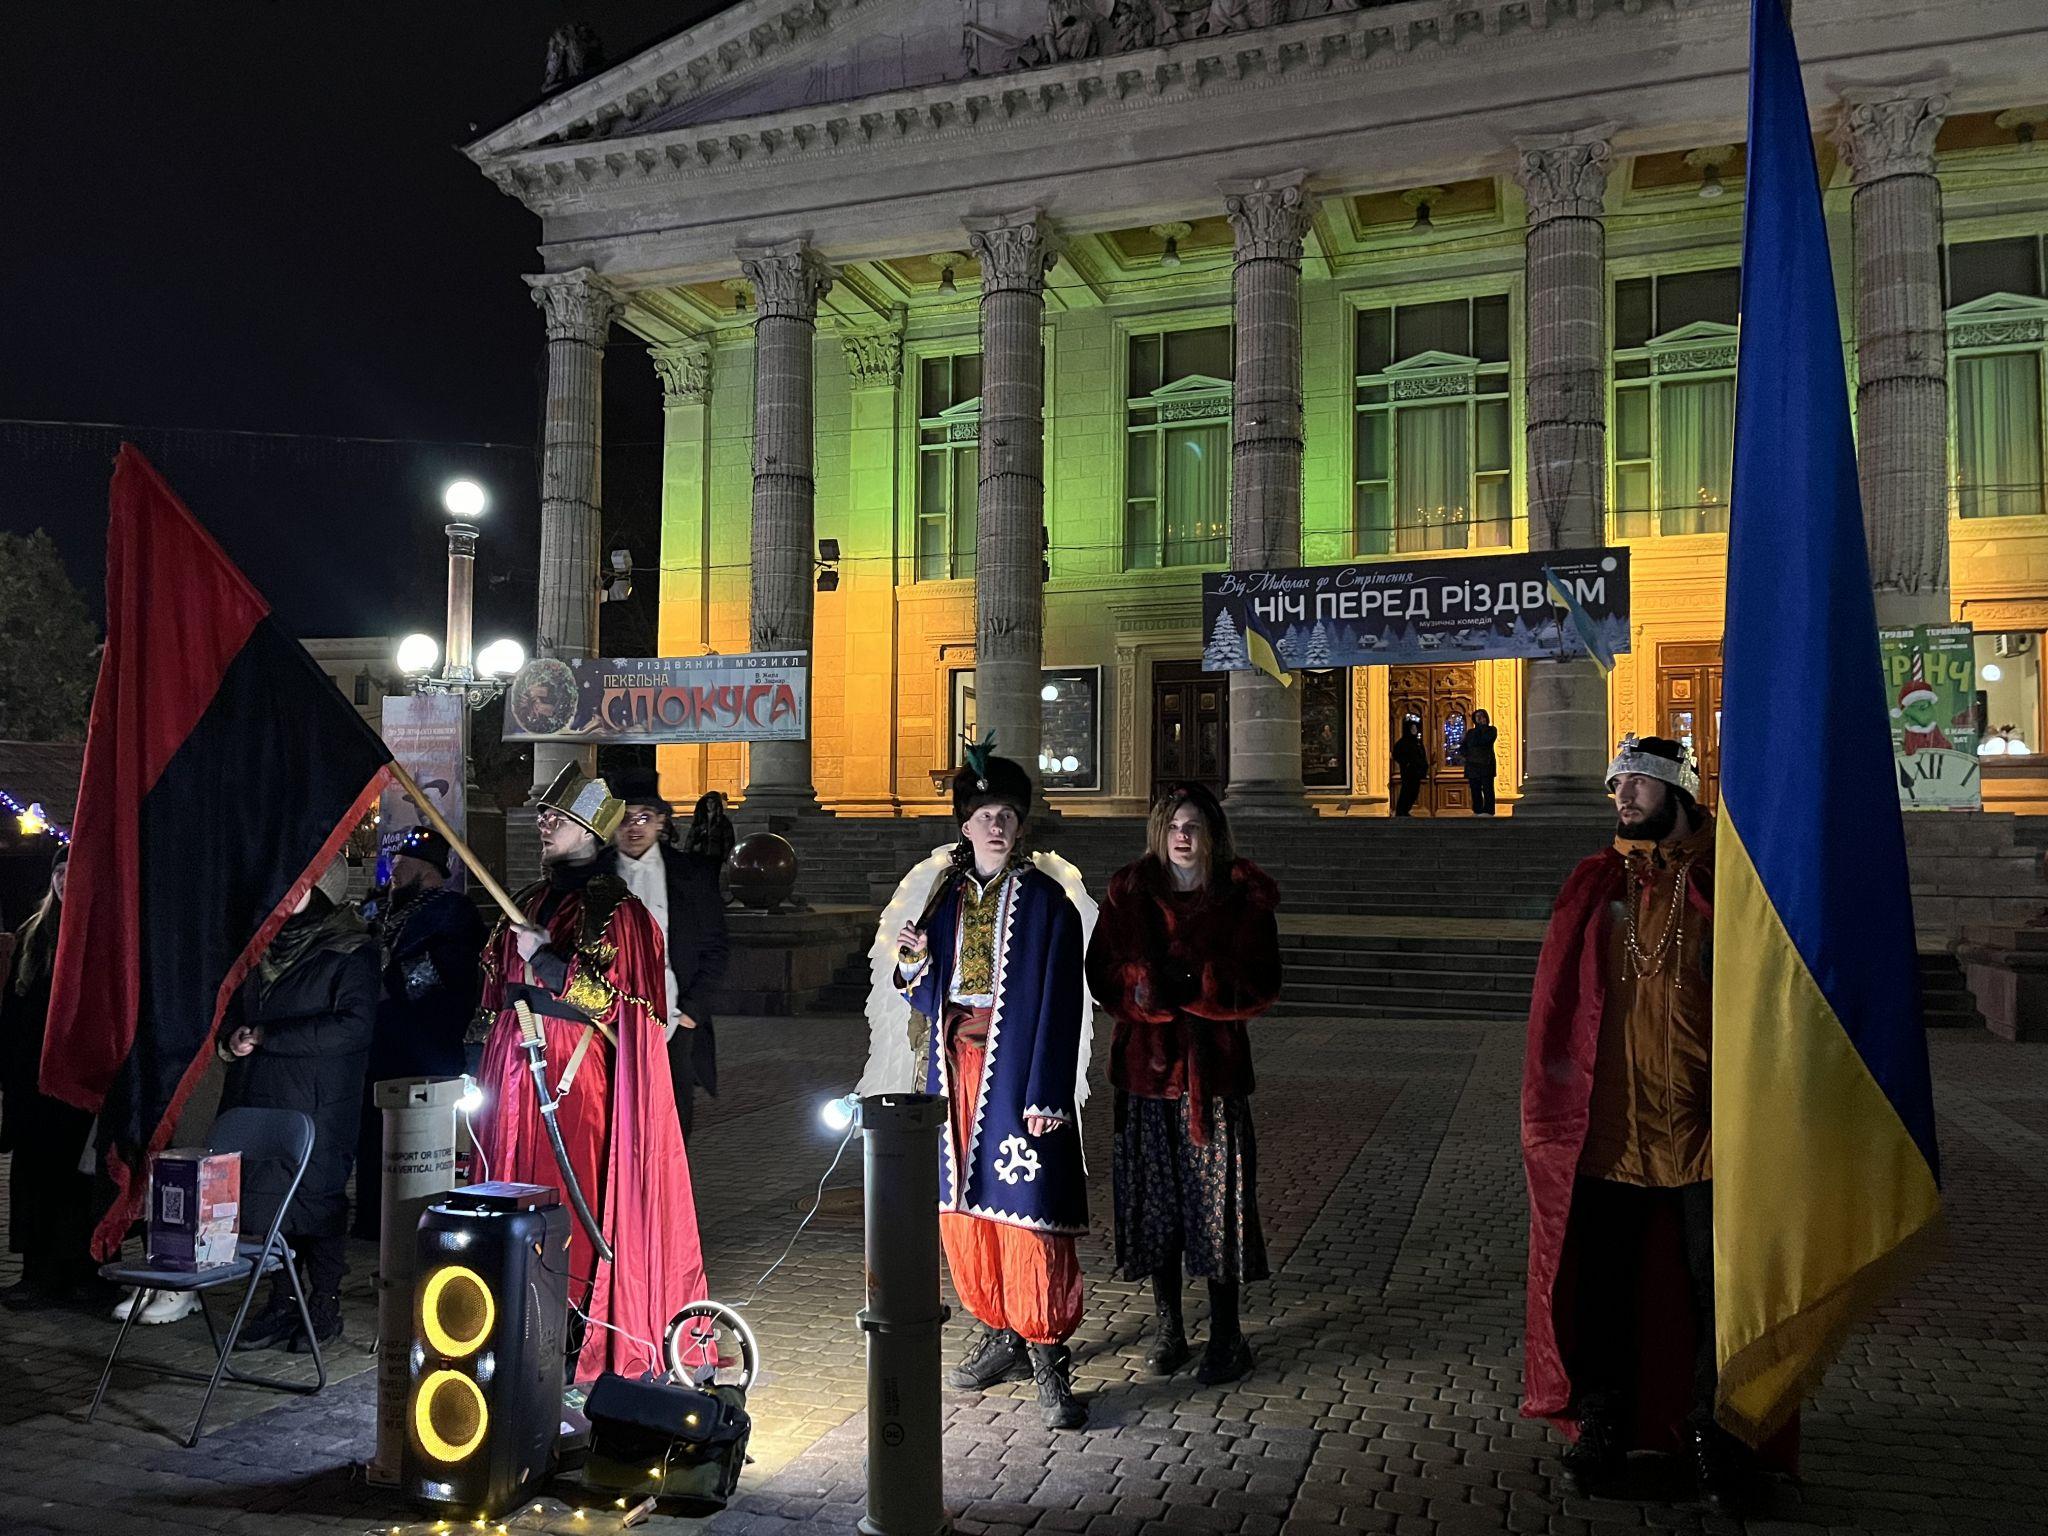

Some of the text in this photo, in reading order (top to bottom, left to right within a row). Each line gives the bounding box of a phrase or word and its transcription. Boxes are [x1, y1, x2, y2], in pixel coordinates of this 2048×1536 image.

[1212, 567, 1414, 598] Від Миколая до Стрітення
[1316, 587, 1430, 620] ПЕРЕД
[1419, 616, 1493, 628] музична комедія
[637, 656, 800, 671] РІЗДВЯНИЙ МЮЗИКЛ
[603, 673, 669, 688] ПЕКЕЛЬНА
[600, 680, 797, 733] СПОКУСА
[399, 1164, 433, 1174] VERTICAL
